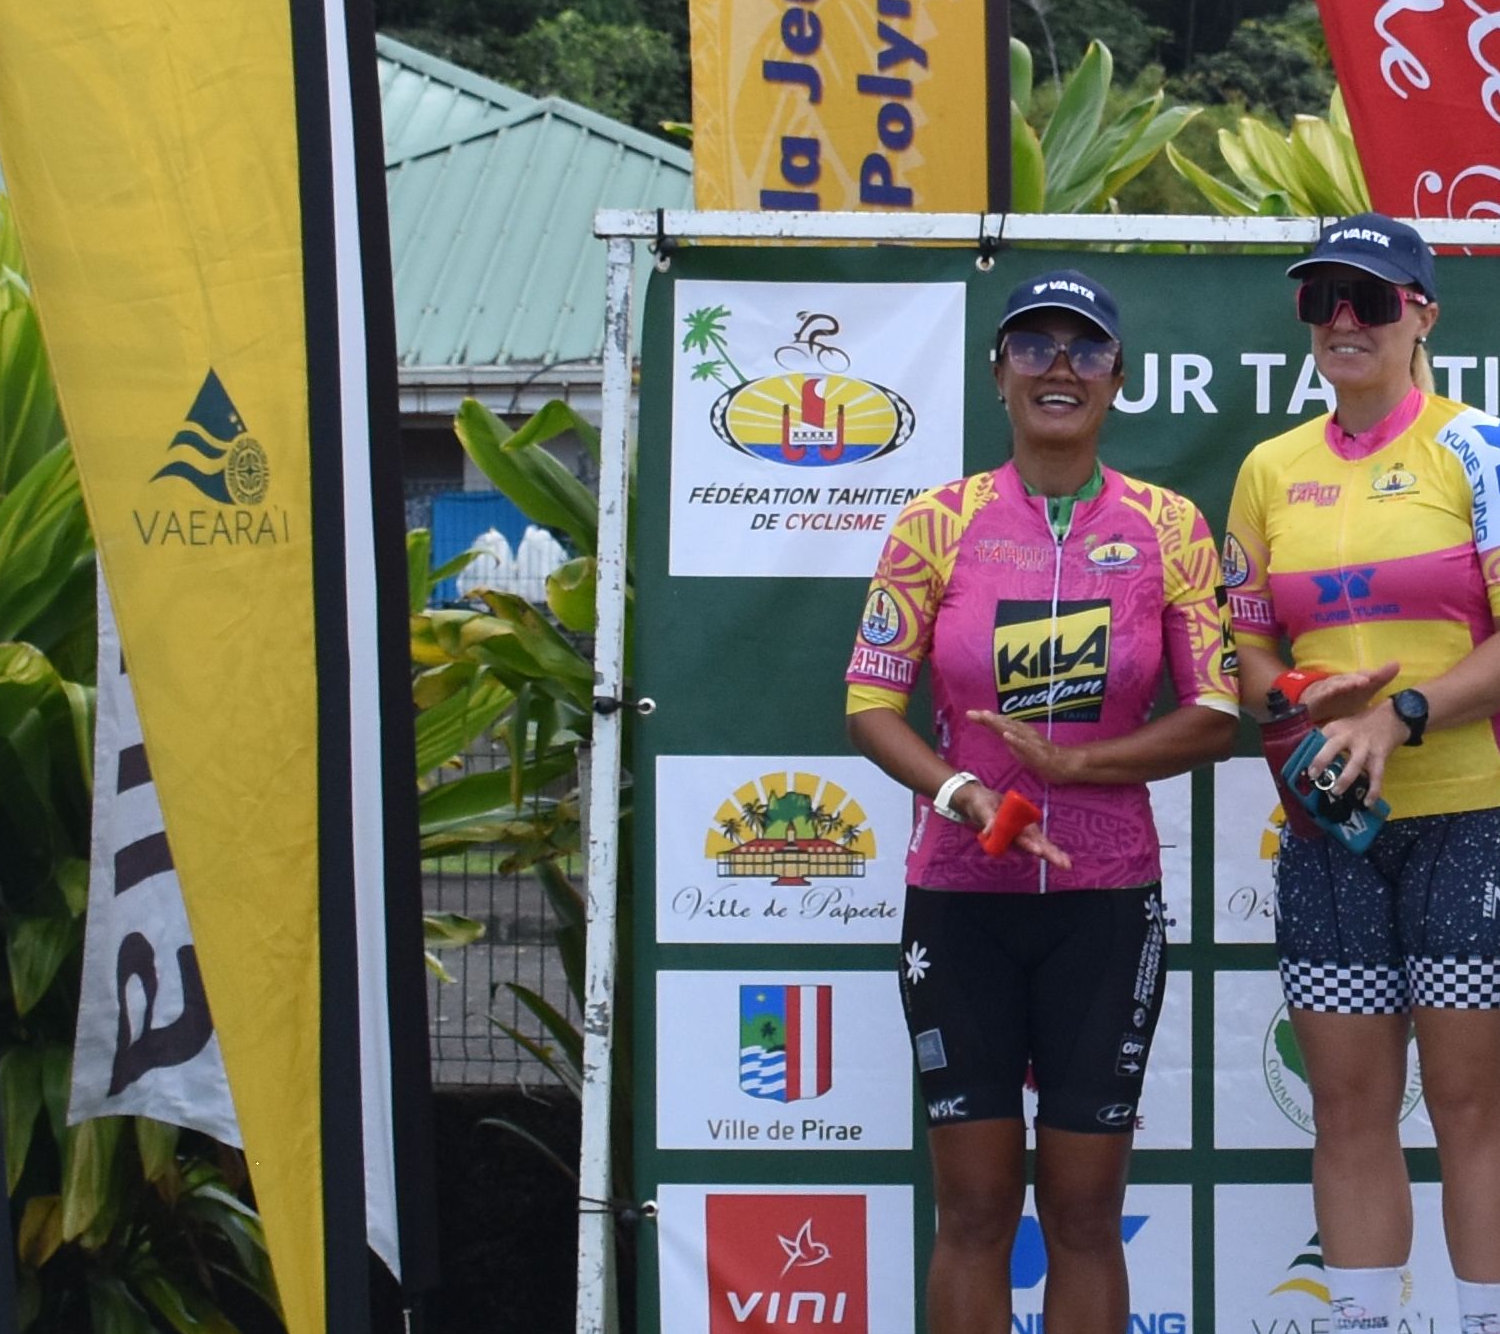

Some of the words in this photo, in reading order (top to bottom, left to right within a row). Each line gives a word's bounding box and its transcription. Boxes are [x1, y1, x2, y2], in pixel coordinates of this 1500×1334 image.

[1341, 227, 1391, 248] VARTA
[1048, 279, 1096, 303] VARTA
[688, 483, 821, 506] FÉDÉRATION
[827, 485, 933, 506] TAHITIEN
[1443, 429, 1481, 477] YUNE
[1473, 474, 1488, 544] TUNG
[750, 513, 781, 531] DE
[785, 512, 887, 532] CYCLISME
[1001, 677, 1103, 714] custom
[672, 883, 751, 922] Ville
[763, 897, 788, 920] de
[800, 885, 898, 924] Papeete
[1267, 1058, 1314, 1127] COMMUNE
[707, 1118, 762, 1141] Ville
[767, 1118, 795, 1141] de
[802, 1119, 863, 1142] Pirae
